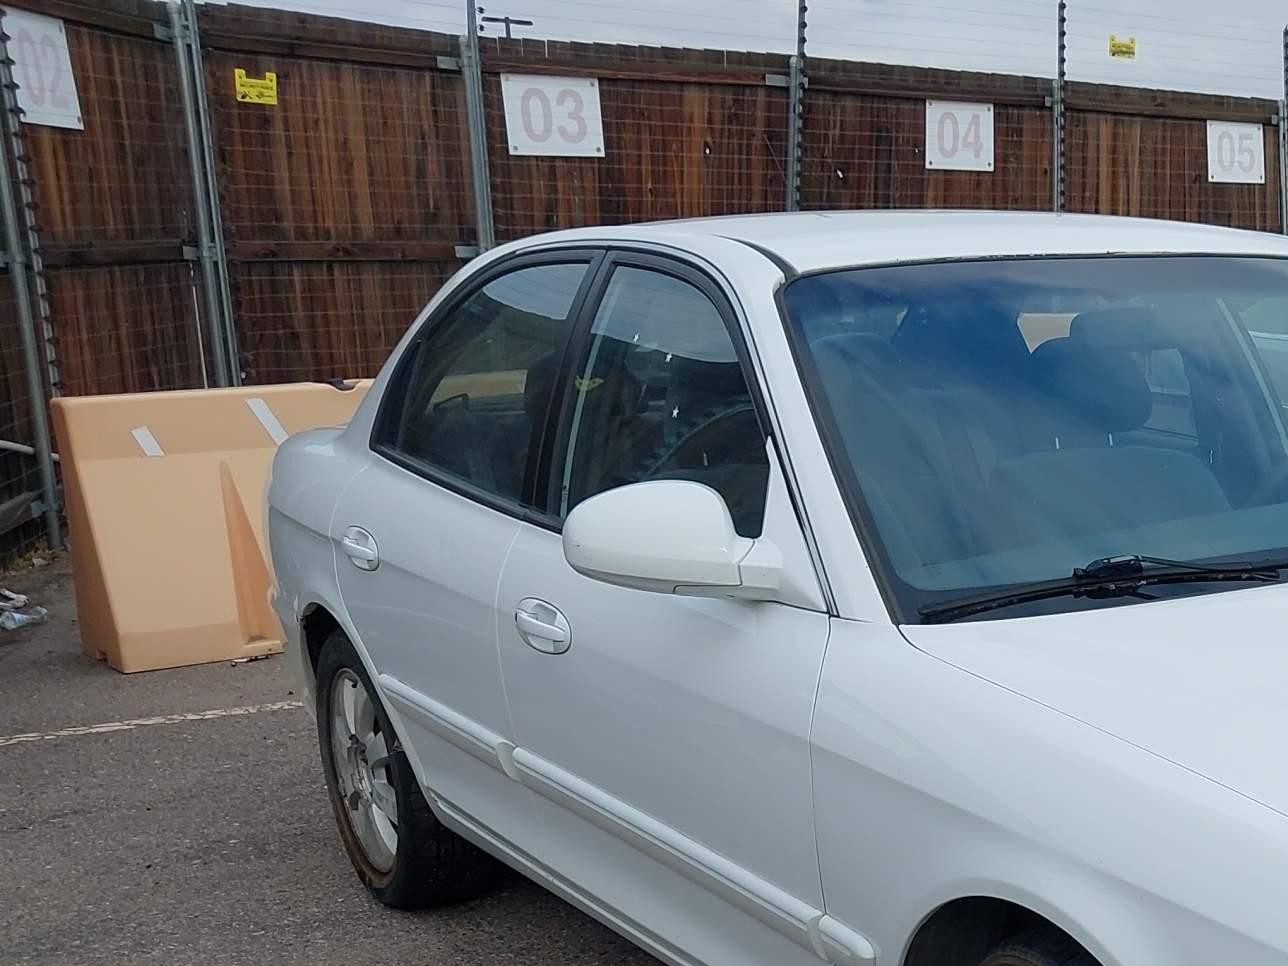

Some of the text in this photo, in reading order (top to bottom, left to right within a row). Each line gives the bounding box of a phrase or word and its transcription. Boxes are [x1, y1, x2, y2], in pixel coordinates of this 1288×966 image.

[17, 28, 70, 110] 02
[521, 87, 587, 144] 03
[937, 111, 983, 159] 04
[1217, 130, 1256, 173] 05
